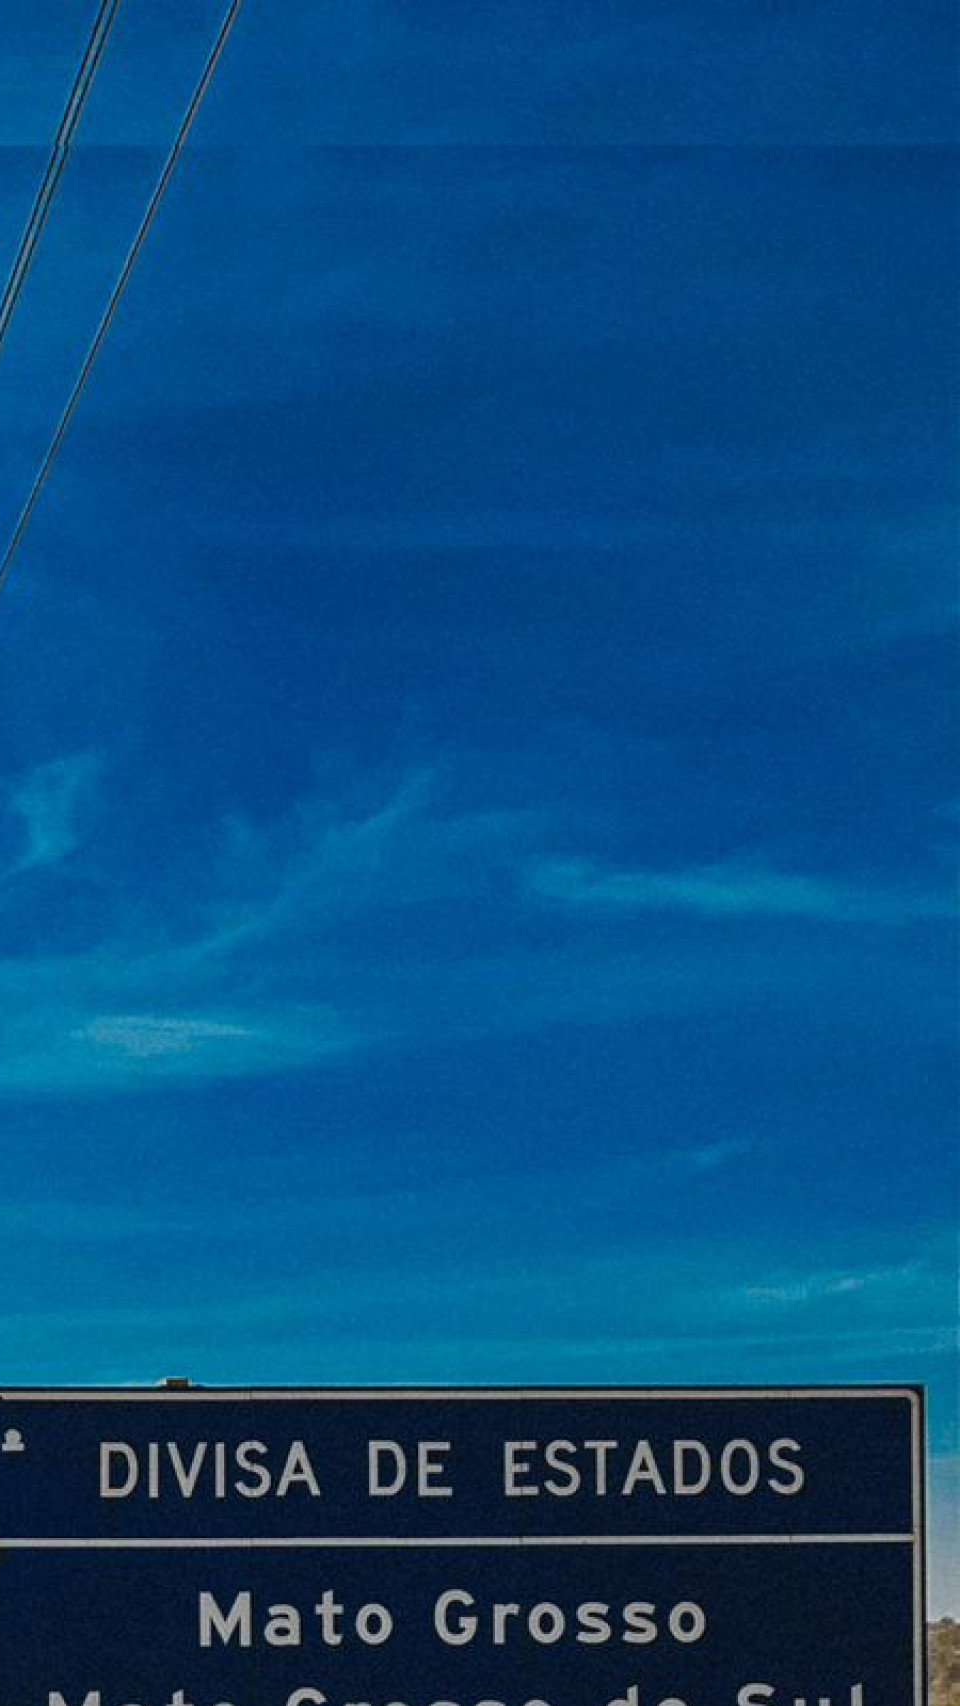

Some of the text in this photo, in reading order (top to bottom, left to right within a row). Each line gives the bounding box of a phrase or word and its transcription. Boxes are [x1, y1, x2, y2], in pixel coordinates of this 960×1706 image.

[99, 1438, 806, 1499] DIVISA DE ESTADOS
[198, 1588, 707, 1648] Mato Grosso
